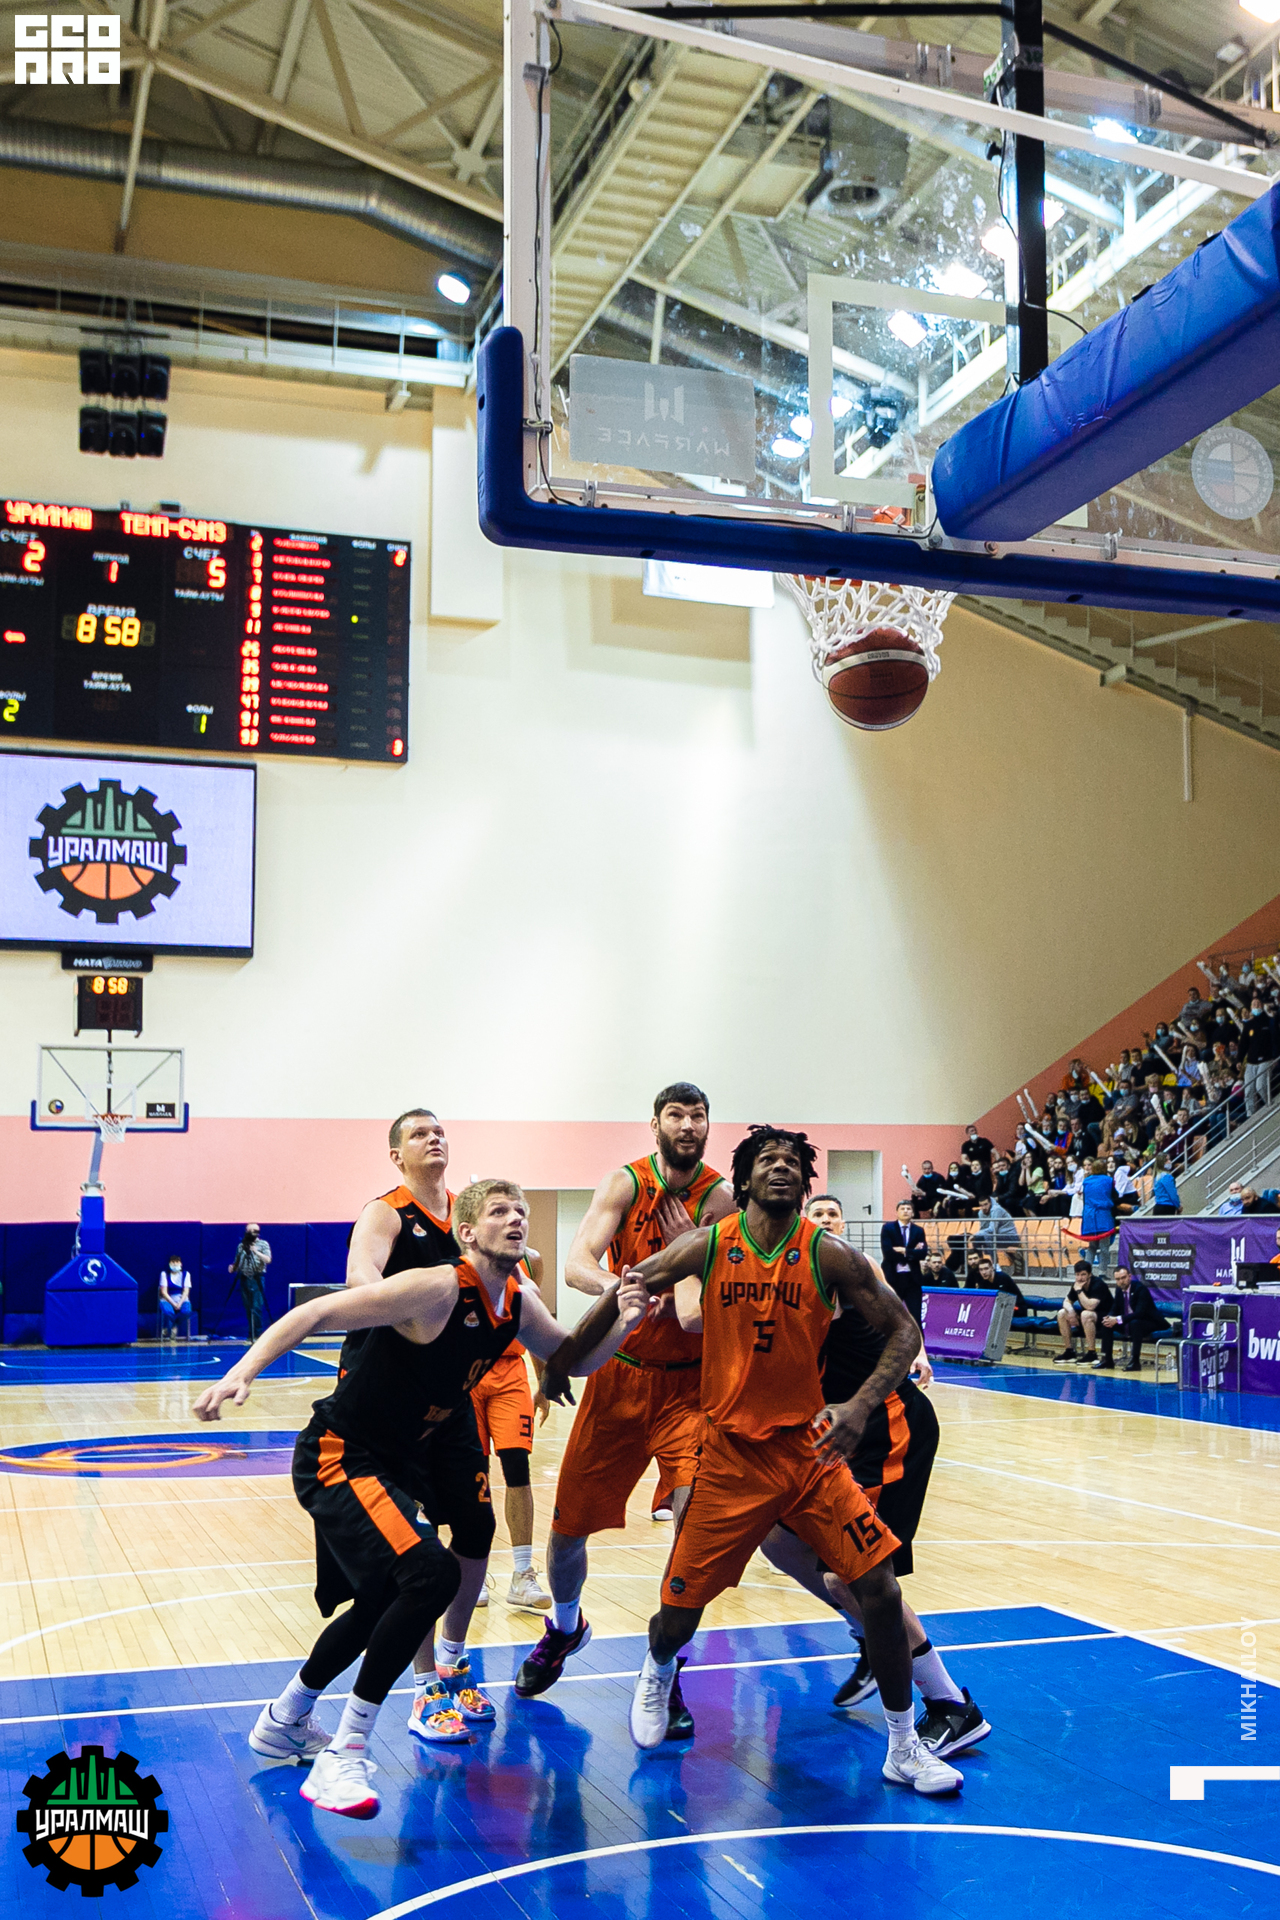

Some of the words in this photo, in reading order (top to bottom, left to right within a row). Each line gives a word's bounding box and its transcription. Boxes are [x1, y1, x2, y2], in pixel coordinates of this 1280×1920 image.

[6, 501, 93, 530] УРАЛМАШ
[120, 511, 227, 543] ТЕМП-СУМЗ
[0, 529, 38, 544] СЧЕТ
[22, 540, 46, 572] 2
[183, 546, 220, 561] СЧЕТ
[109, 560, 119, 583] 1
[207, 557, 227, 589] 5
[87, 604, 136, 617] ВРЕМЯ
[245, 618, 262, 635] 11
[2, 699, 20, 722] 2
[185, 704, 214, 715] ФОЛЫ
[200, 714, 208, 734] 1
[48, 835, 169, 874] УРАЛМАШ
[752, 1320, 777, 1354] 5
[944, 1327, 975, 1338] WARFACE
[842, 1509, 884, 1555] 15
